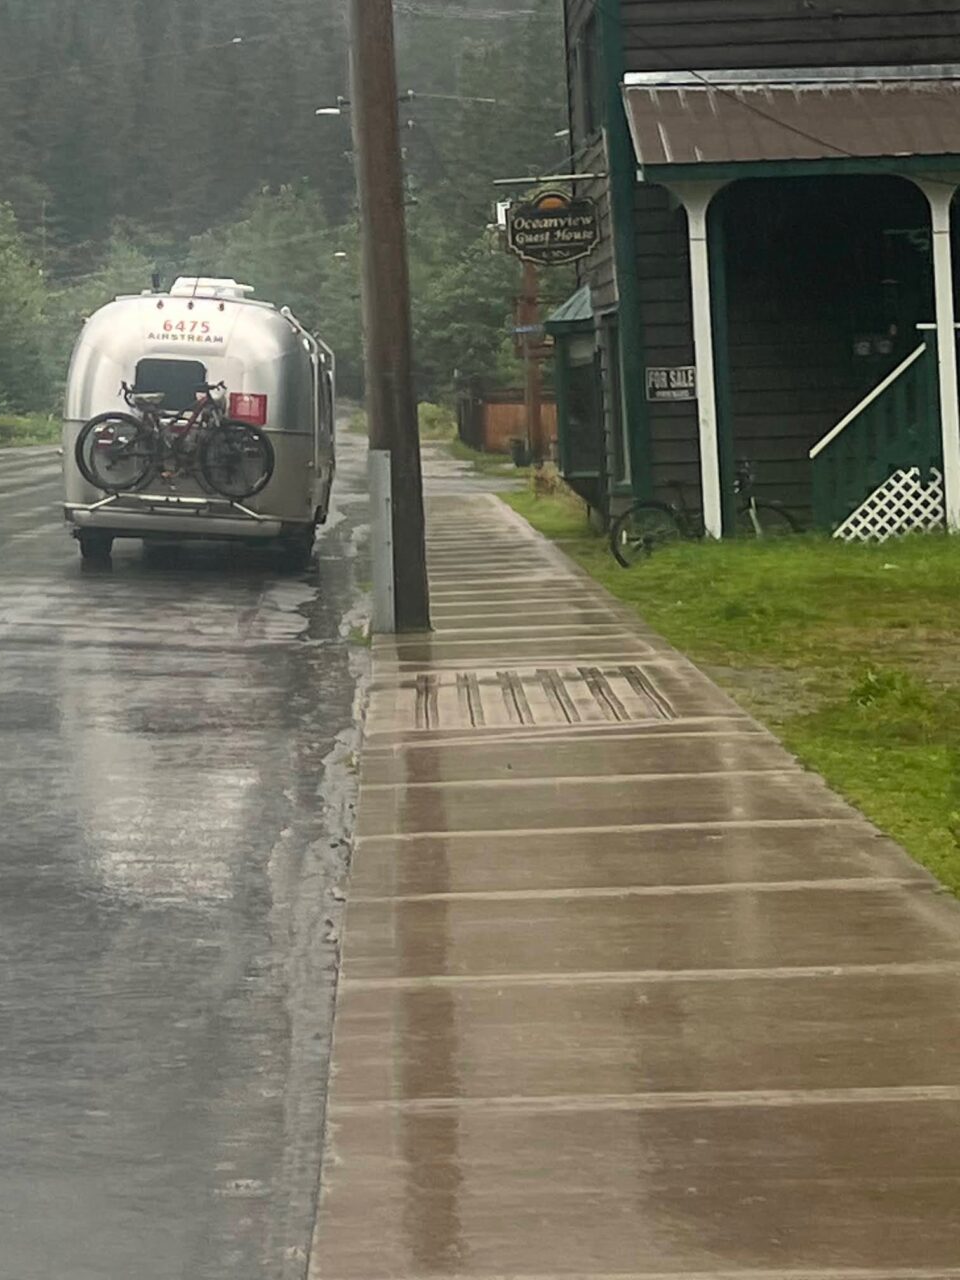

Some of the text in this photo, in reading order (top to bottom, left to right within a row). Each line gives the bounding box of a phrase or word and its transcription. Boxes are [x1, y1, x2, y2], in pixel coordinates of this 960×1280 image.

[514, 216, 593, 230] Oceanview
[515, 228, 594, 247] Guest House
[163, 320, 210, 334] 6475
[148, 332, 224, 343] AIRSTREAM
[648, 369, 695, 389] FOR SALE
